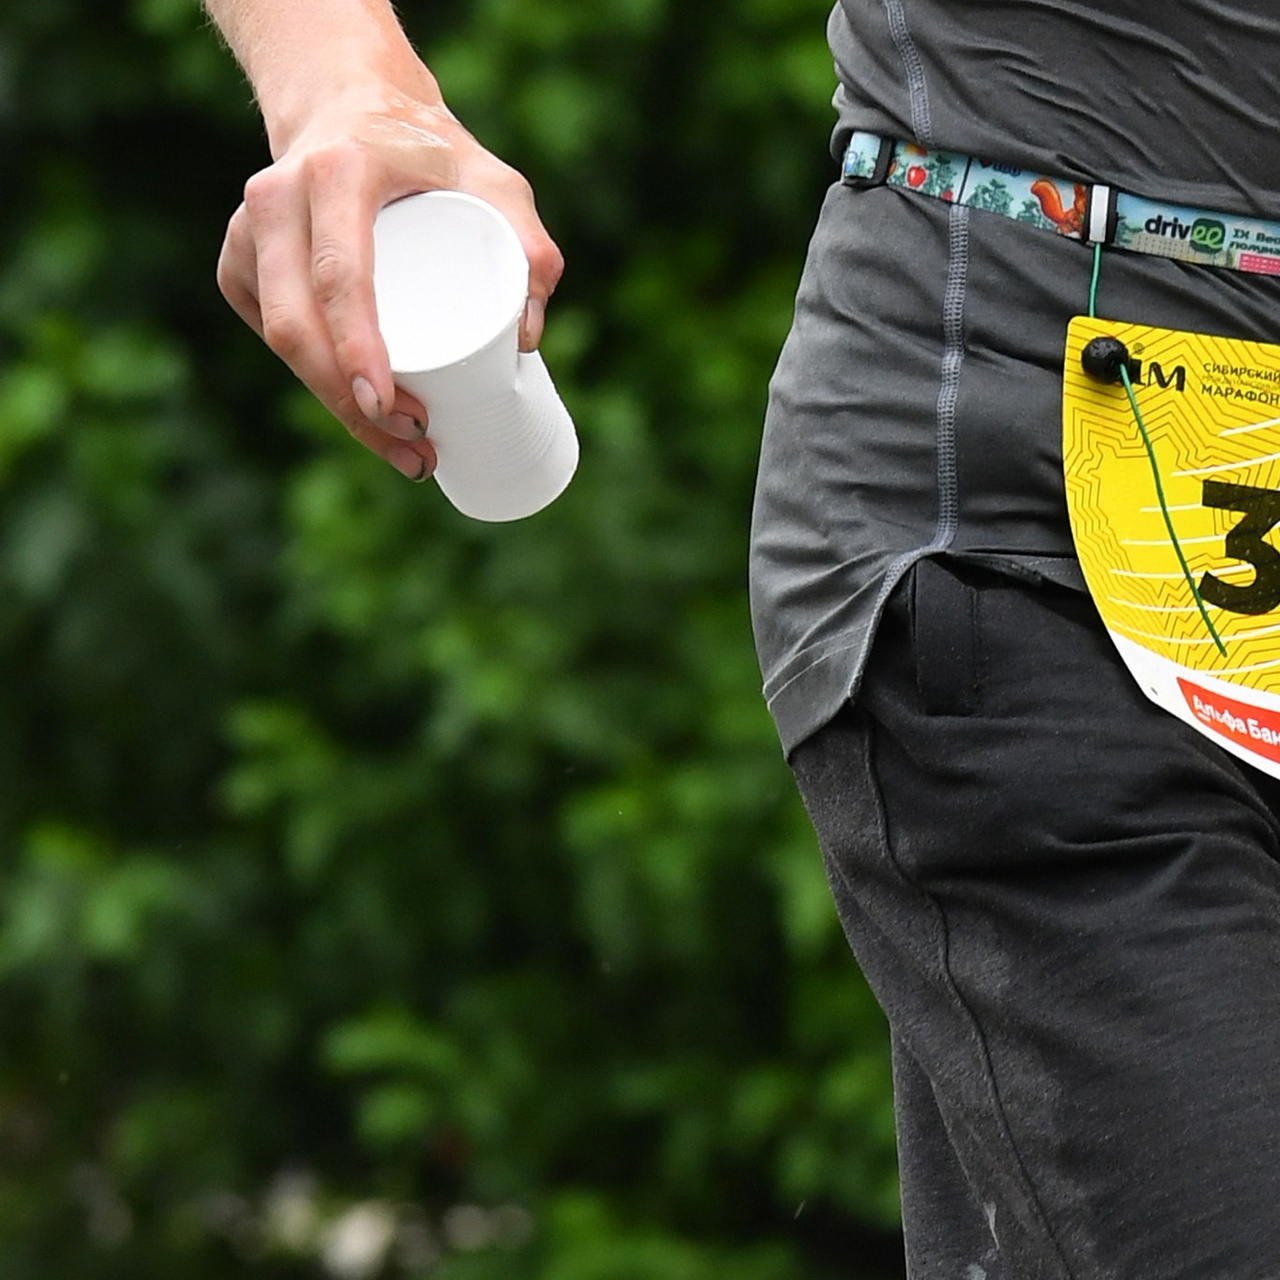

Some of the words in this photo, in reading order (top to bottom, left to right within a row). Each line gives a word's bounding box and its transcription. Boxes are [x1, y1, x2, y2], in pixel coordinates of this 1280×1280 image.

[1145, 215, 1224, 251] drivee
[1201, 383, 1280, 406] МАРАФОН
[1192, 694, 1247, 734] Альфа
